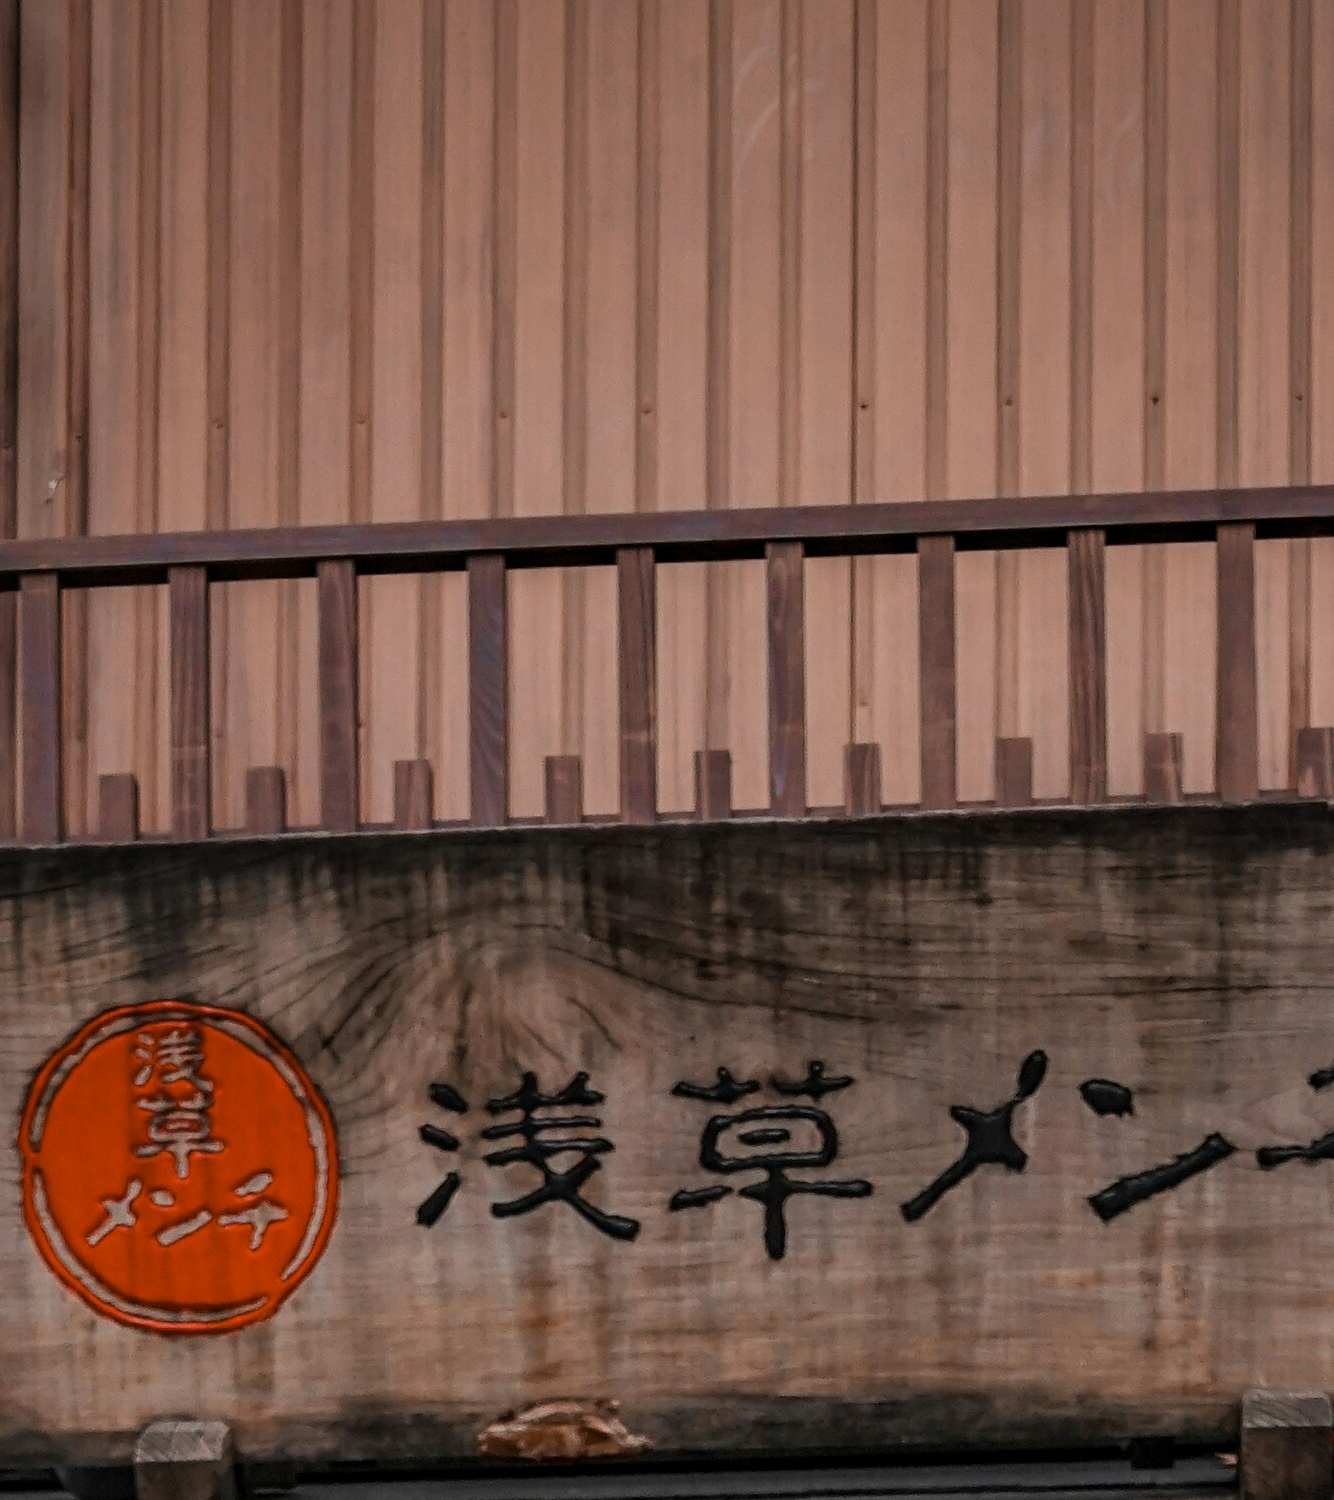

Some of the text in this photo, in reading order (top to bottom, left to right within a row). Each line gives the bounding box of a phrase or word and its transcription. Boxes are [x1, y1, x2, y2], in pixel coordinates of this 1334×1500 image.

[133, 1030, 225, 1181] 浅草
[84, 1167, 290, 1251] メンチ
